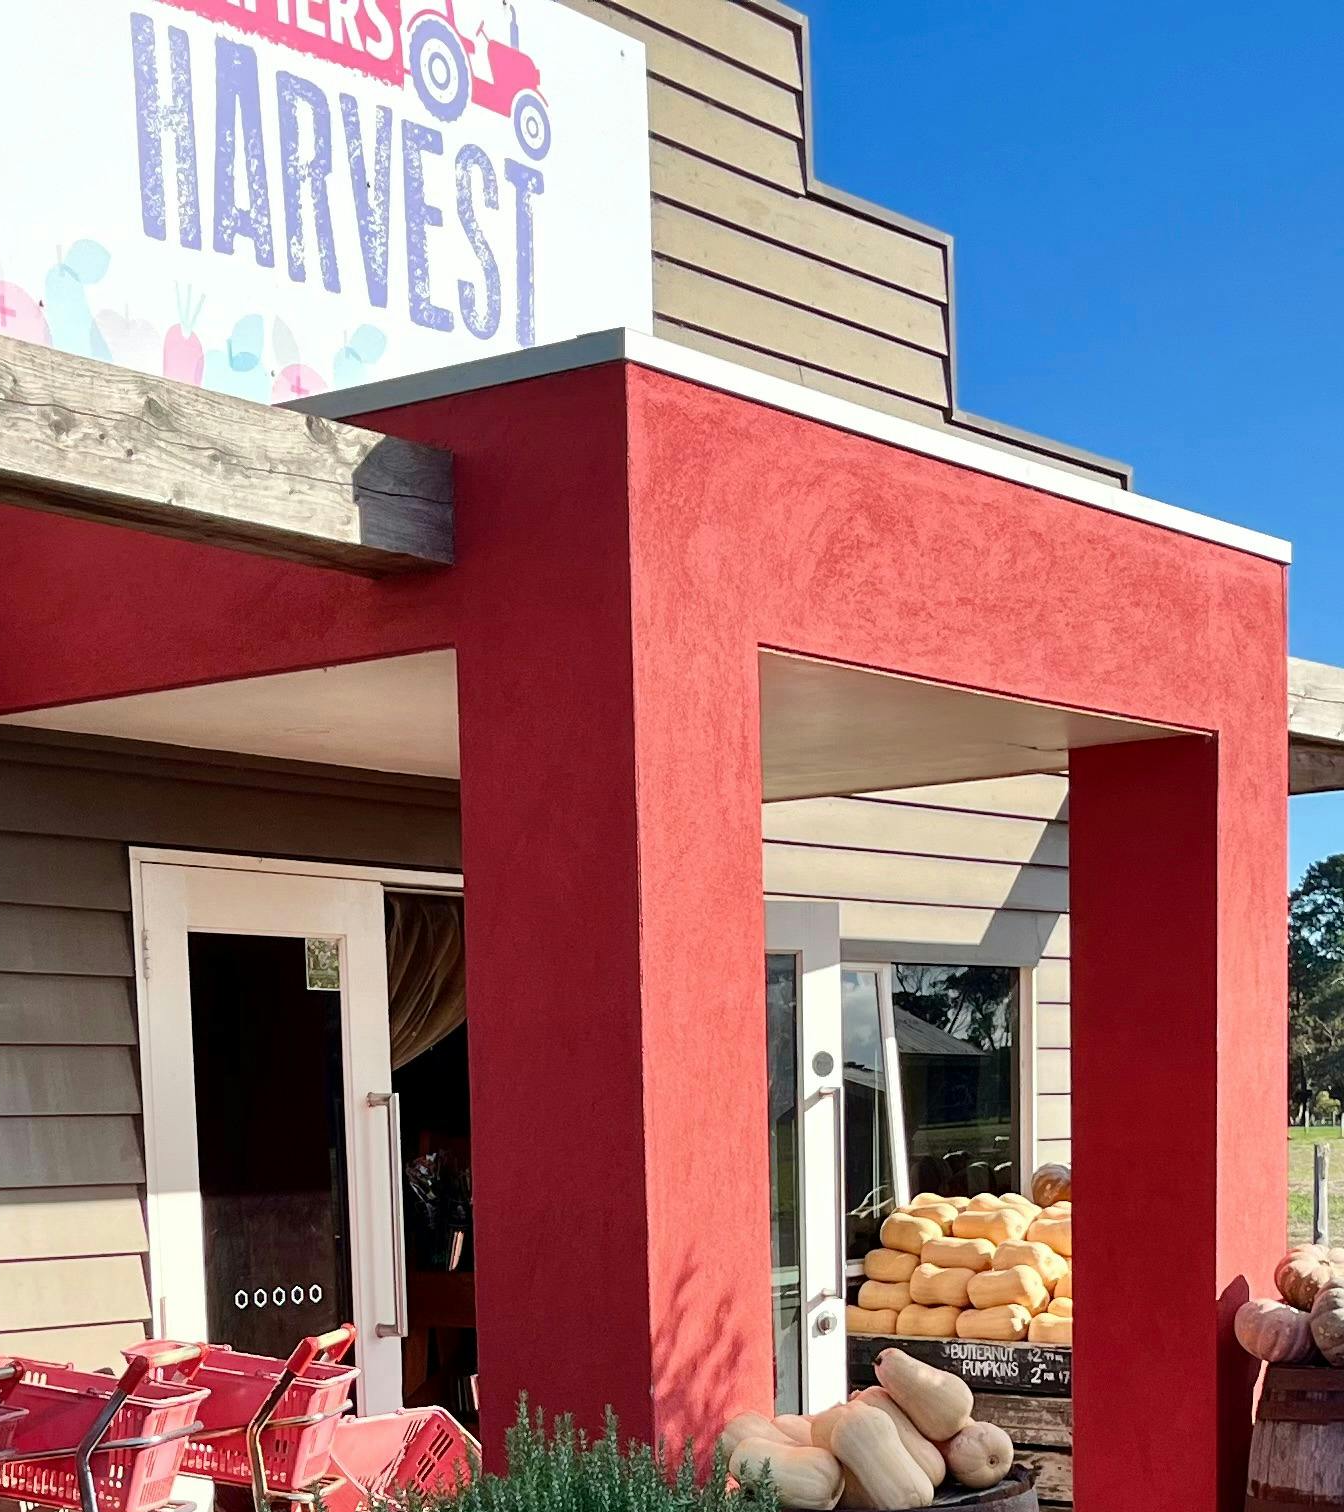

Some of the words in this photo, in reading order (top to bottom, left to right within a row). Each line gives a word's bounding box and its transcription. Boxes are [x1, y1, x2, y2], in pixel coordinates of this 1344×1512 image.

[130, 12, 545, 346] HARVEST
[950, 1343, 1014, 1361] BUTTERNUT
[962, 1359, 1019, 1378] PUMPKINS
